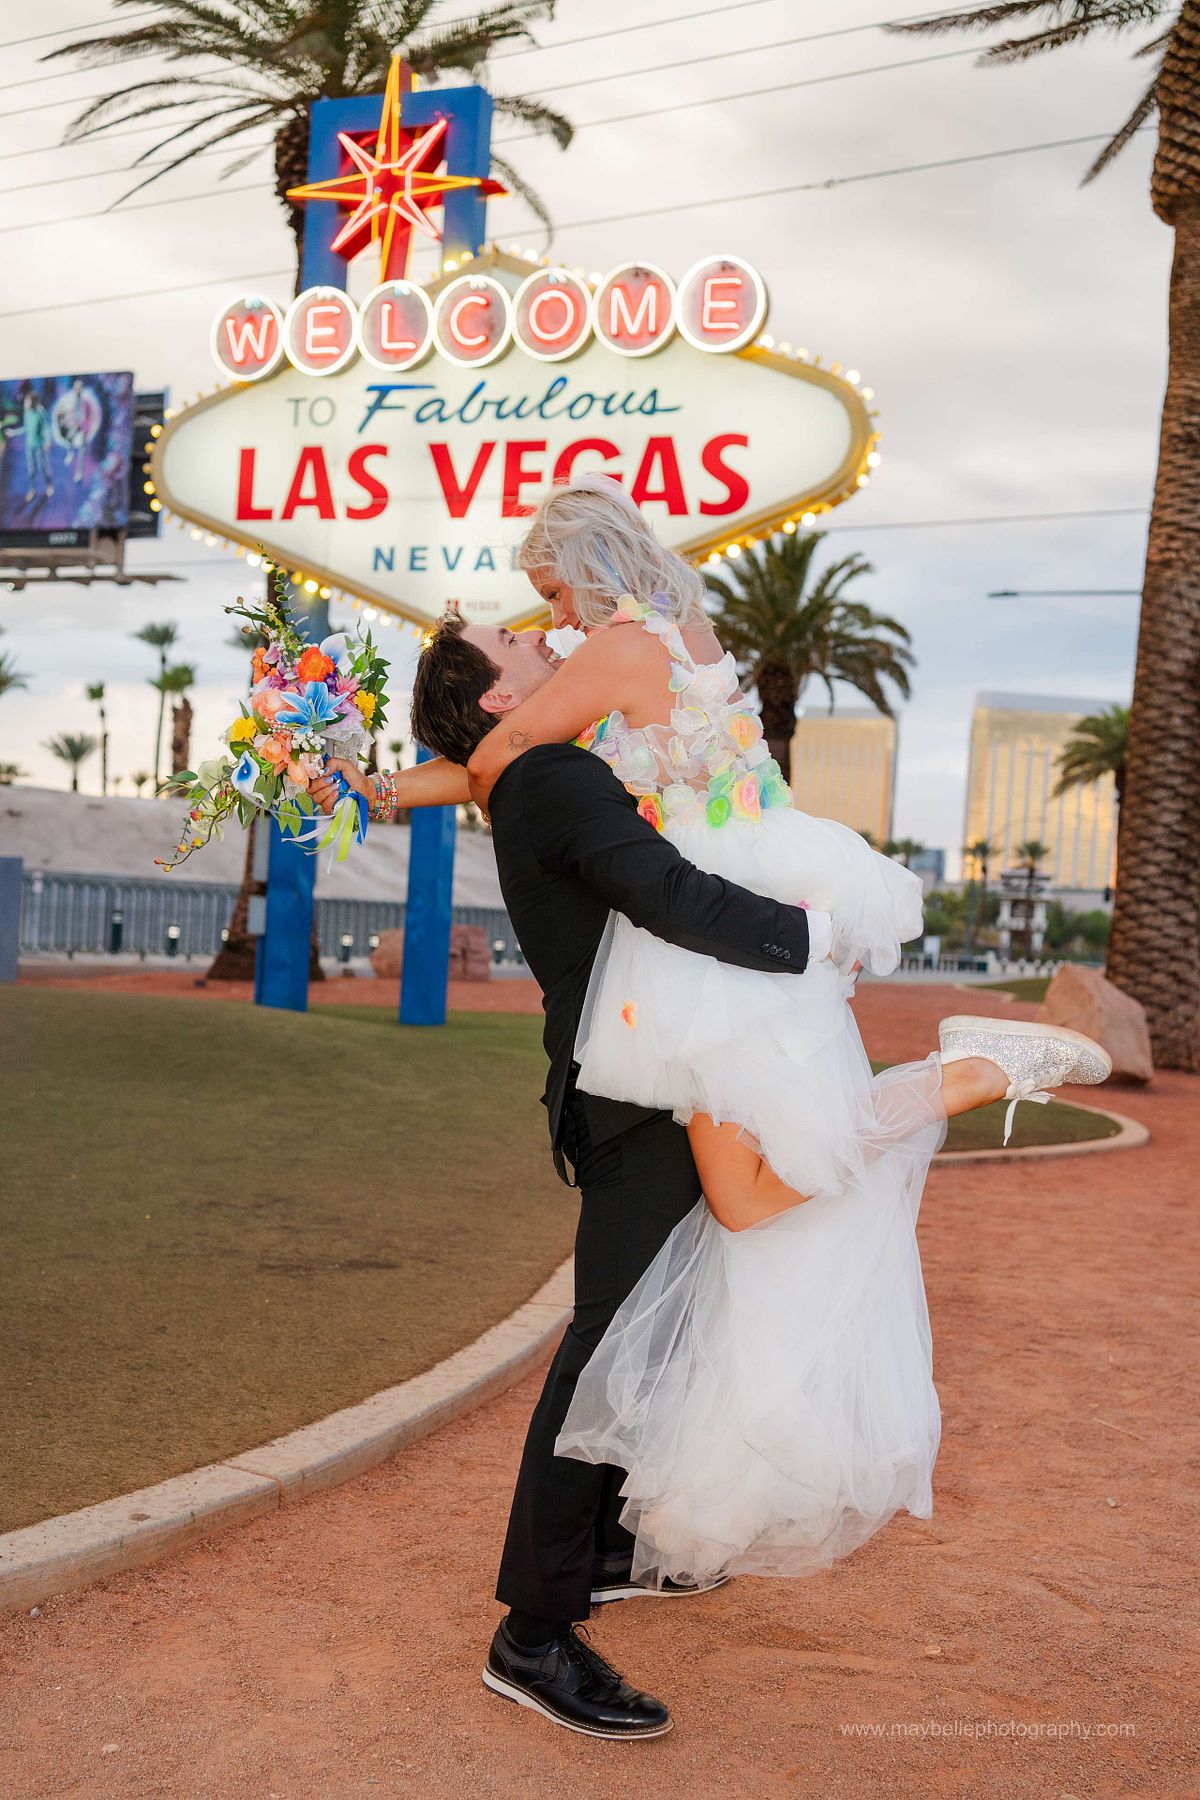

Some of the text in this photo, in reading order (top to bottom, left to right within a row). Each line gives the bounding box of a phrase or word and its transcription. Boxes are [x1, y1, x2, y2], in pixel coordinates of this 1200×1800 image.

[225, 275, 743, 364] WELCOME
[287, 377, 682, 433] TO Fabulous
[236, 433, 749, 521] LAS VEGAS
